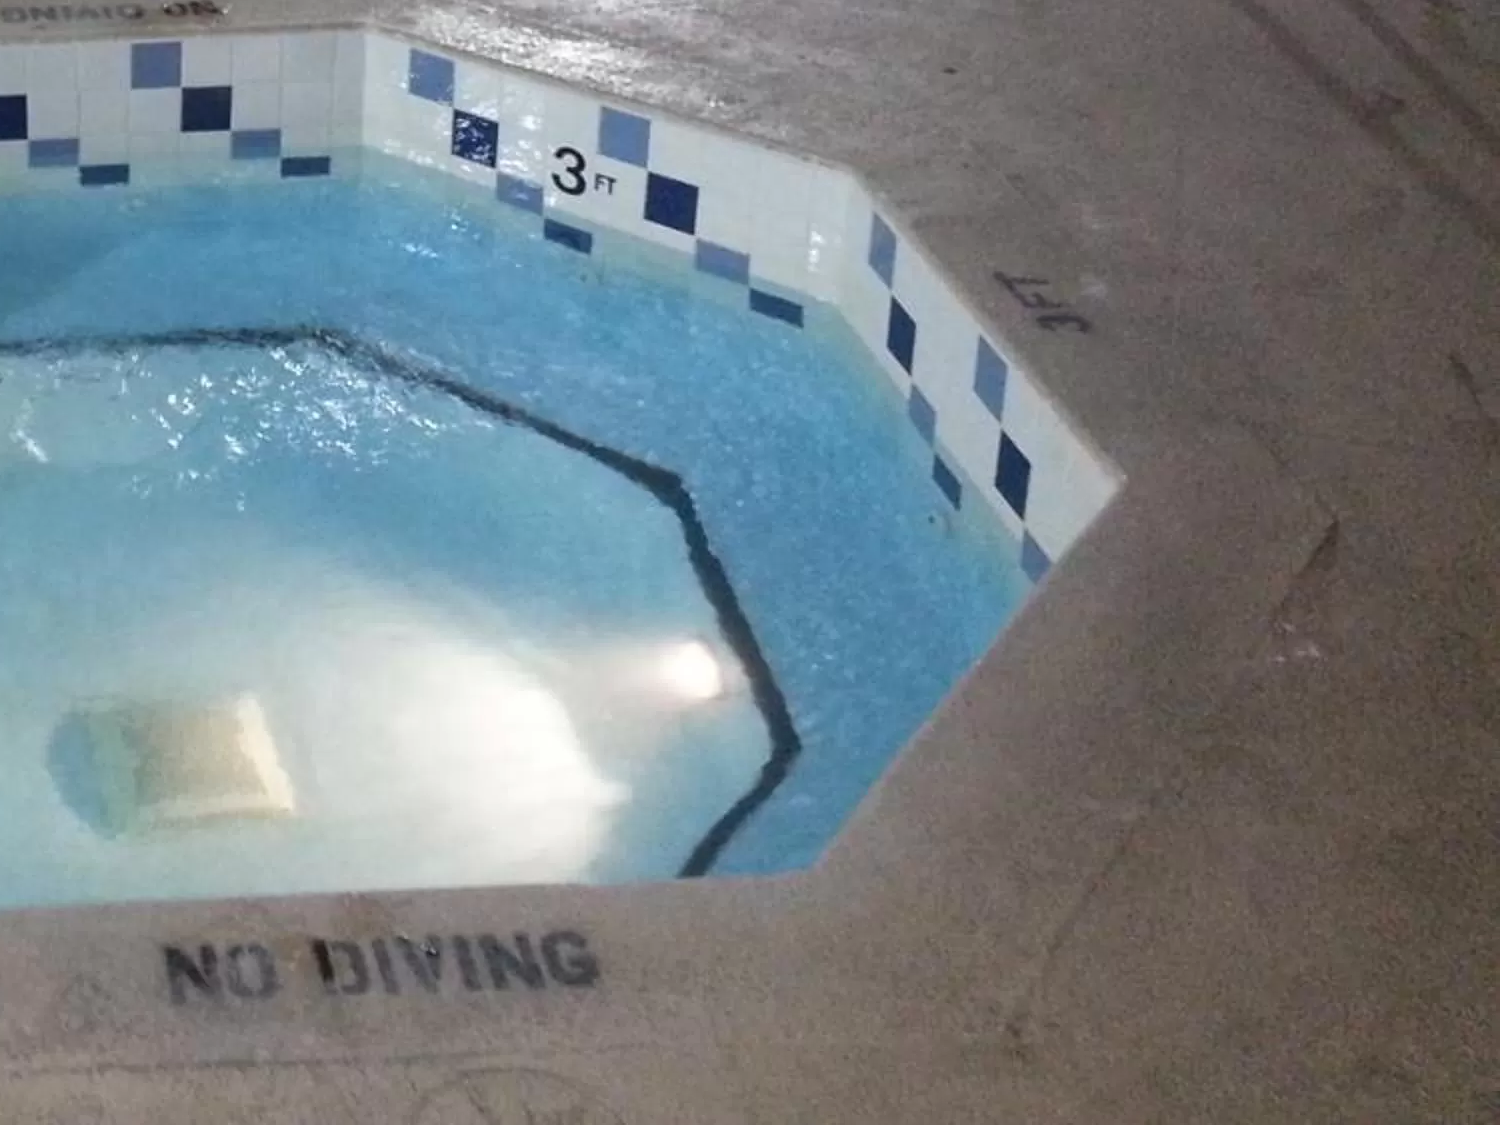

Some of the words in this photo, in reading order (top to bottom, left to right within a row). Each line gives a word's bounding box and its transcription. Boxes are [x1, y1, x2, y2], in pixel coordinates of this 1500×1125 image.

[551, 146, 586, 196] 3
[593, 173, 617, 195] FT
[163, 943, 279, 1006] NO
[311, 930, 600, 996] DIVING
